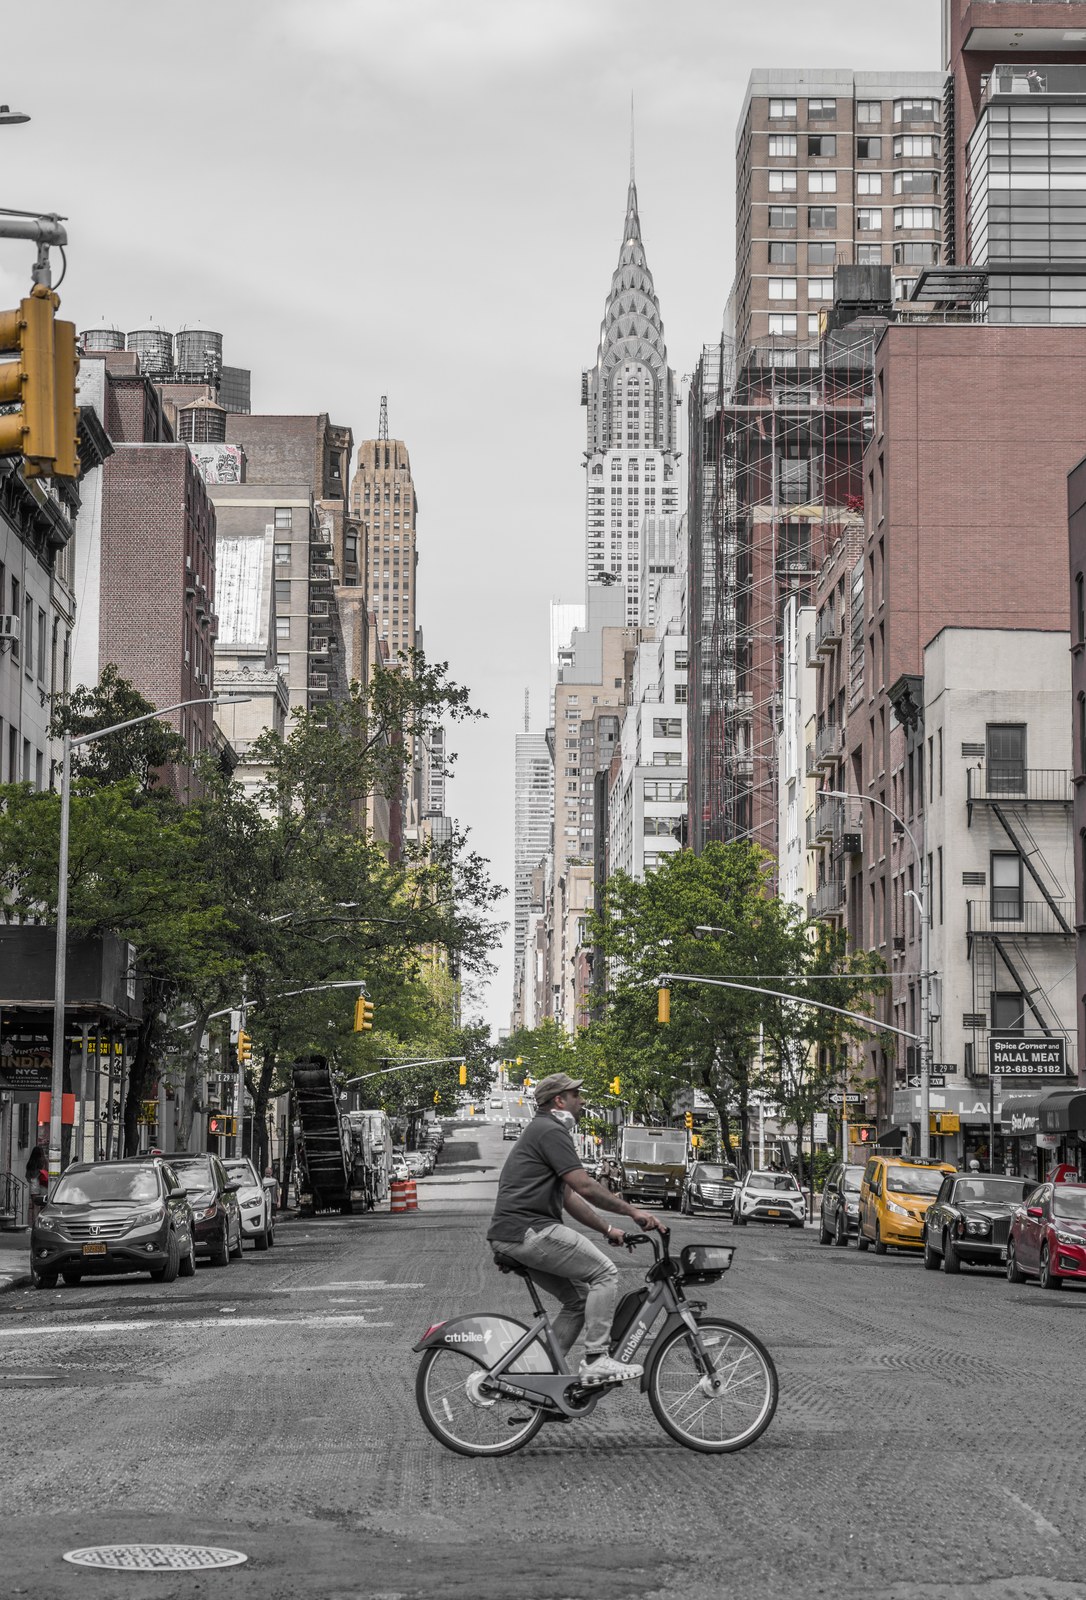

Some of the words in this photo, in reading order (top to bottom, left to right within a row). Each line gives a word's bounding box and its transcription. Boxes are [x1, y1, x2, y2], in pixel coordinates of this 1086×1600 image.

[13, 1046, 51, 1055] VINTAGE
[995, 1042, 1017, 1051] Spice
[1018, 1042, 1047, 1050] Corner
[994, 1052, 1029, 1062] HALAL
[1031, 1052, 1060, 1062] MEAT
[1, 1056, 52, 1069] INDIA
[933, 1065, 938, 1073] E
[940, 1065, 948, 1073] 29
[994, 1065, 1061, 1073] 212-689-5182
[218, 1074, 222, 1082] E
[223, 1074, 230, 1082] 29
[461, 1331, 483, 1342] bike
[626, 1328, 644, 1349] bike
